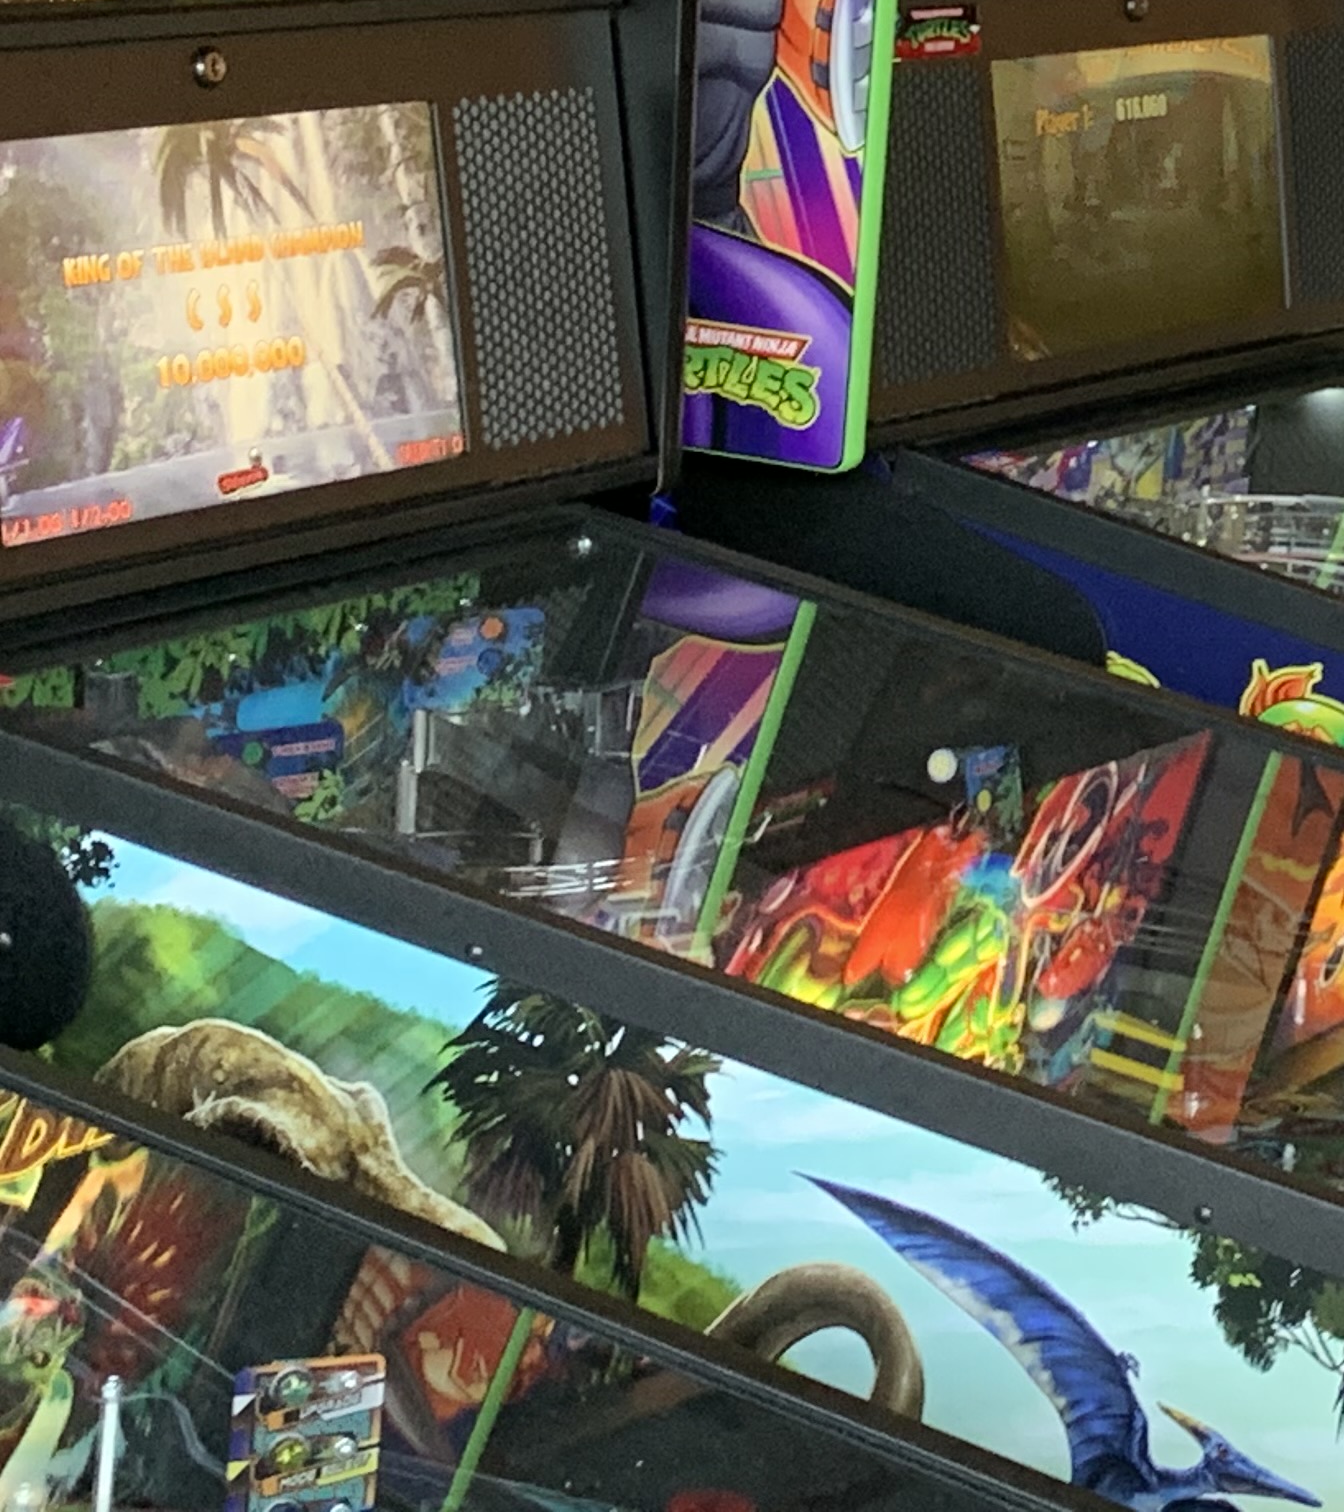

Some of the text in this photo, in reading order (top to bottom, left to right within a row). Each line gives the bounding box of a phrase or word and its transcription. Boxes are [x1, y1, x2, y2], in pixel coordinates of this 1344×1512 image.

[62, 253, 111, 287] KING
[115, 249, 145, 280] OF
[151, 242, 196, 275] THE
